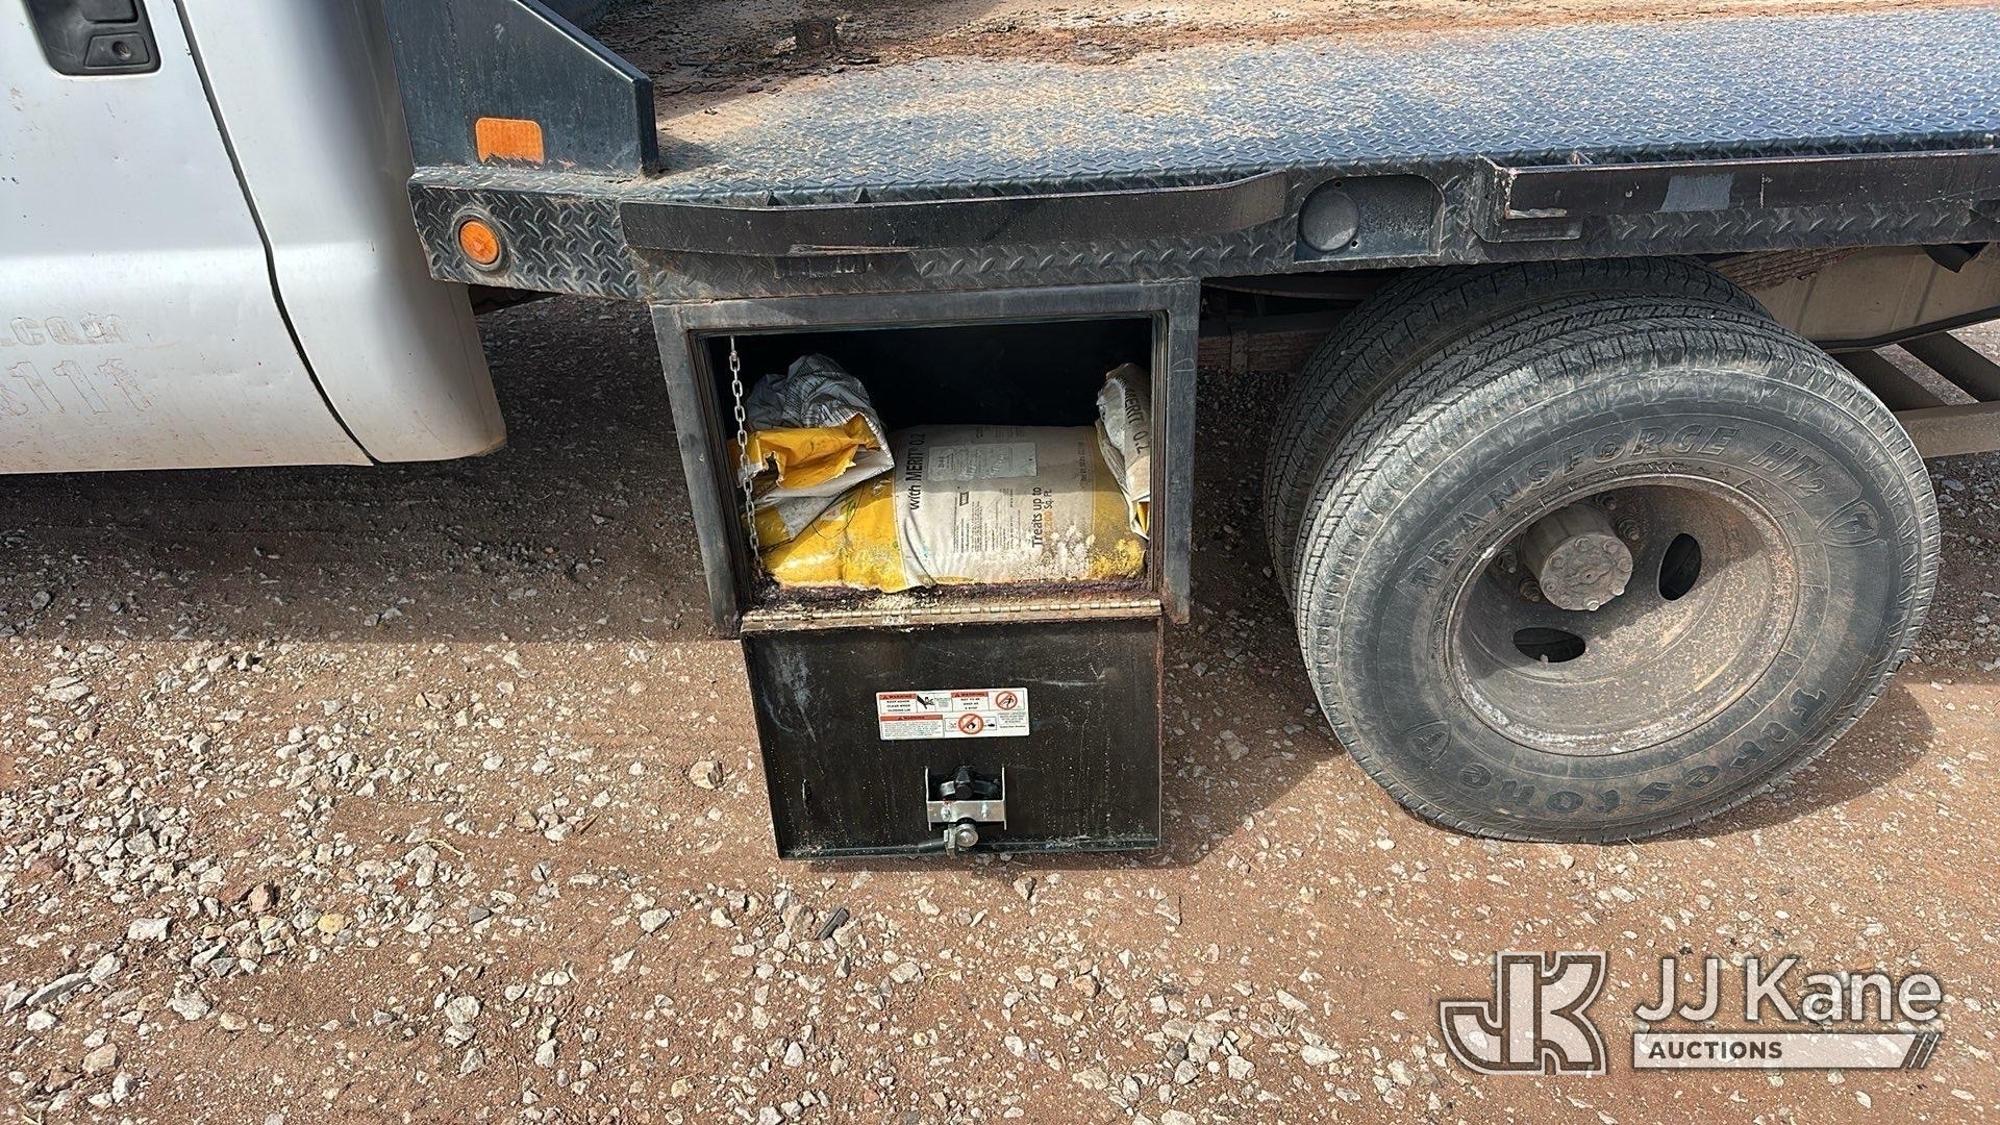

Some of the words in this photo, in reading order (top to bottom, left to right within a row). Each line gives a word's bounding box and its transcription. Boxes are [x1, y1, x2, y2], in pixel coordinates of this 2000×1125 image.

[1749, 440, 1827, 498] HT2
[908, 484, 922, 511] with
[1032, 486, 1042, 497] to
[1032, 498, 1046, 511] up
[1032, 513, 1044, 548] Treats
